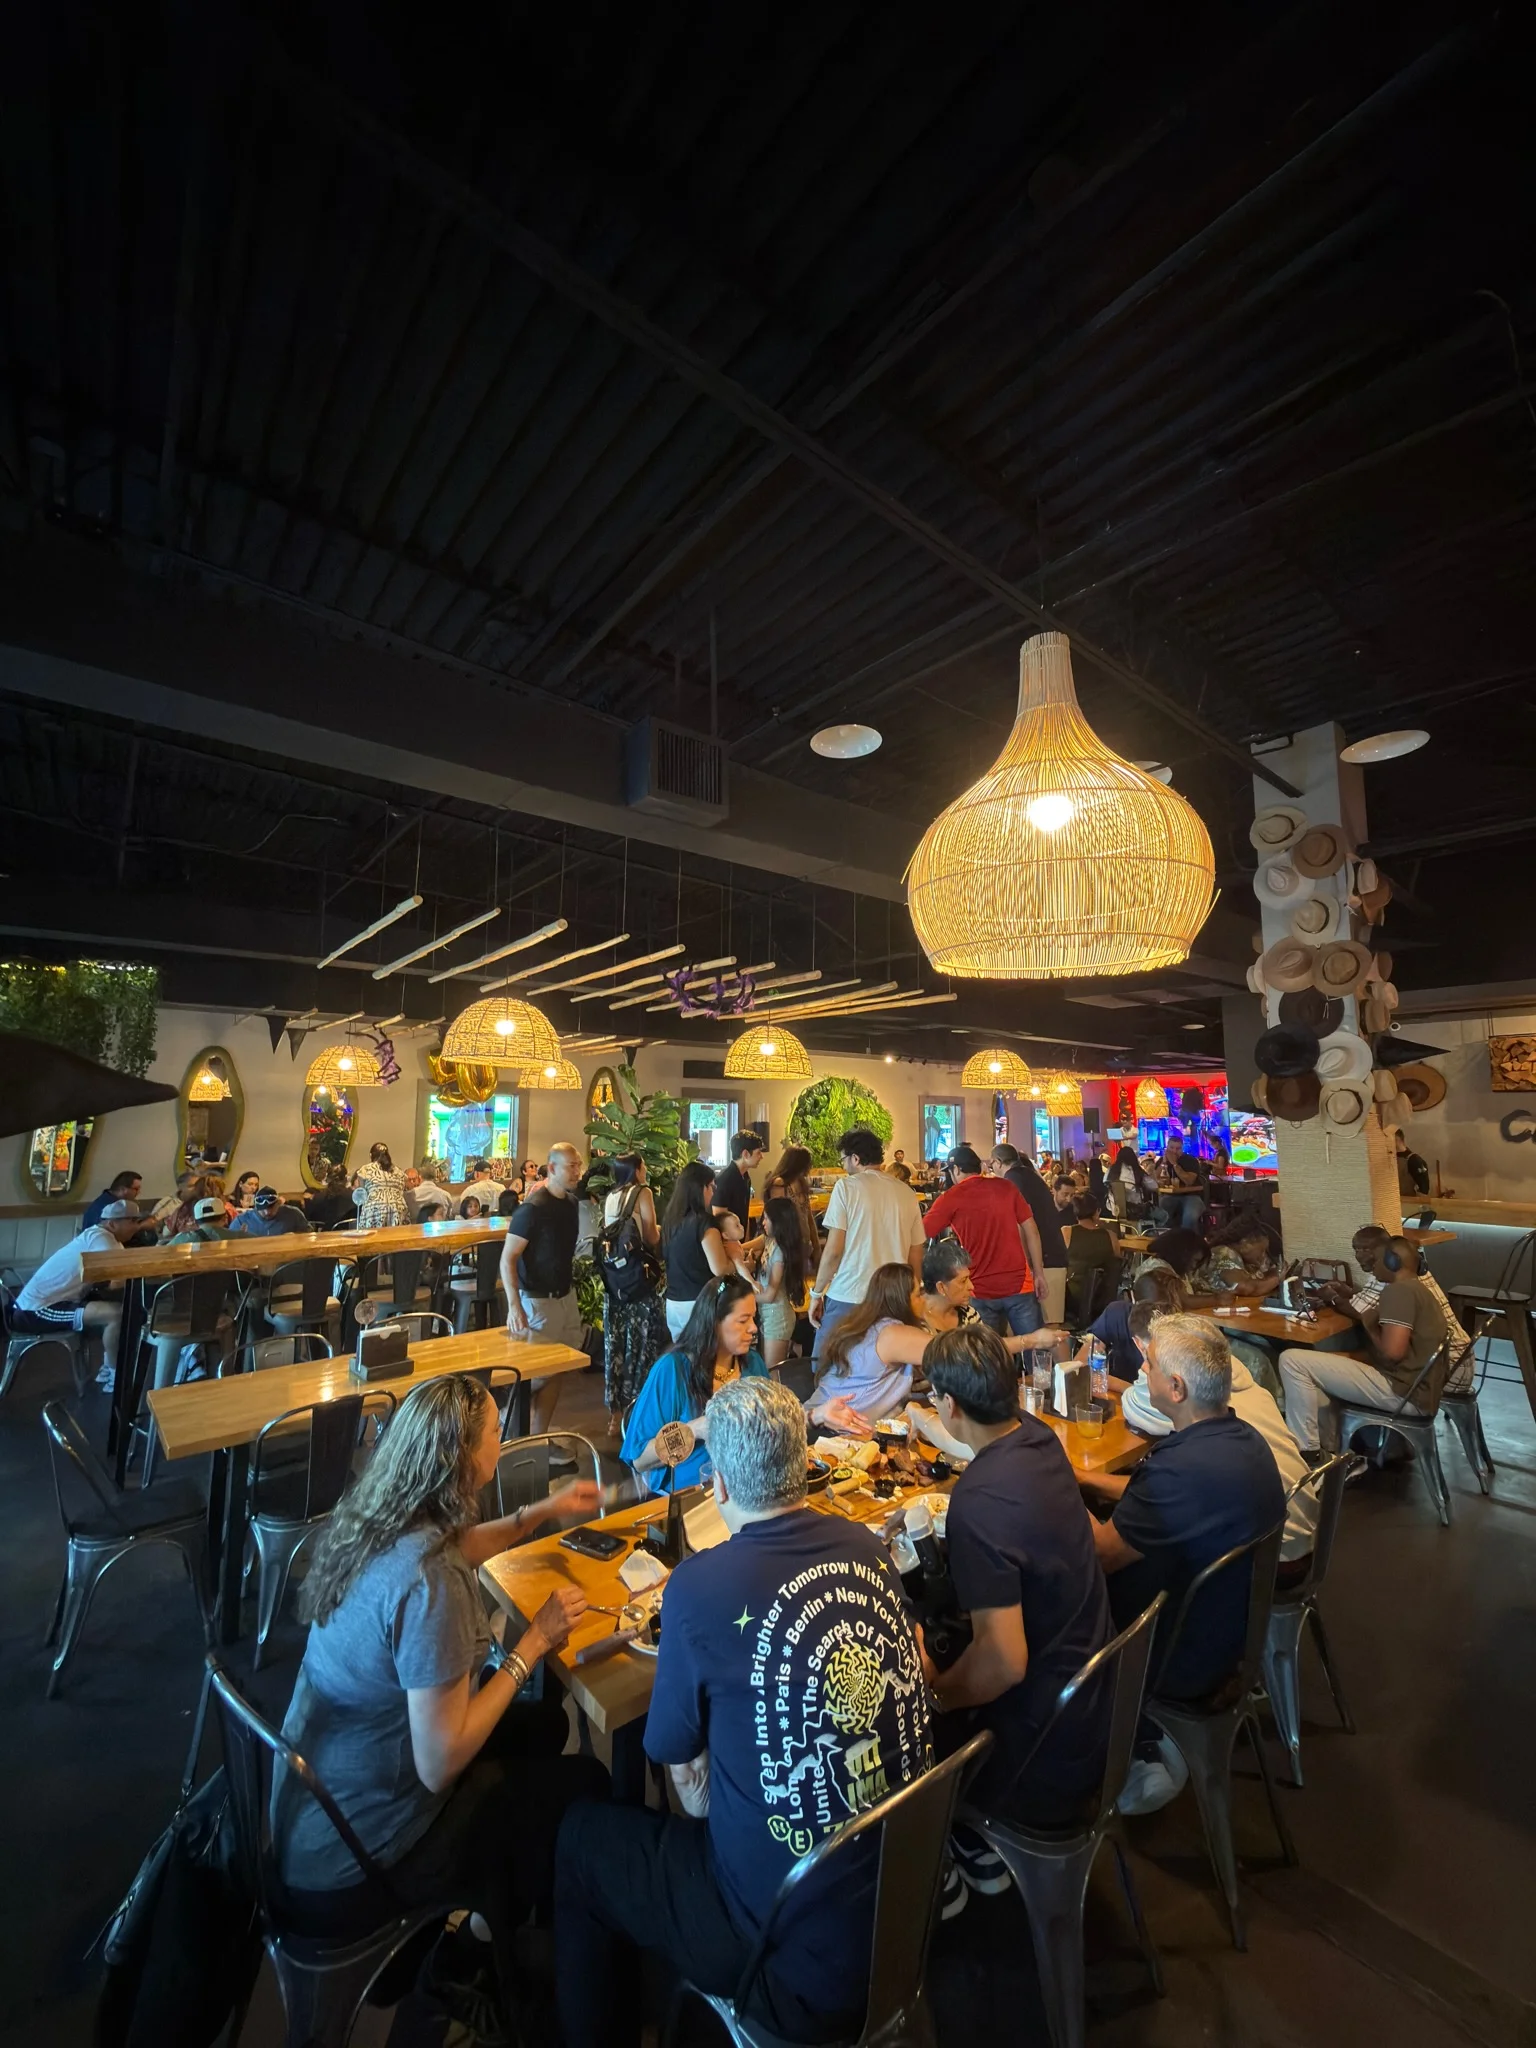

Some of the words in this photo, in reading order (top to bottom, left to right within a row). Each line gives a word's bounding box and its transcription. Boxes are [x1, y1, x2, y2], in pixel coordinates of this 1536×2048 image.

[1500, 1109, 1536, 1146] C
[662, 1422, 679, 1435] MENU
[778, 1561, 849, 1601] Tomorrow
[835, 1587, 868, 1607] New
[852, 1561, 885, 1592] With
[785, 1597, 825, 1645] Berlin
[855, 1620, 875, 1642] Of
[872, 1596, 899, 1636] York
[750, 1600, 783, 1687] Brighter
[808, 1619, 853, 1672] Search
[802, 1675, 819, 1718] The
[755, 1700, 769, 1747] Into
[761, 1753, 779, 1805] Sep
[782, 1736, 804, 1820] Lonon
